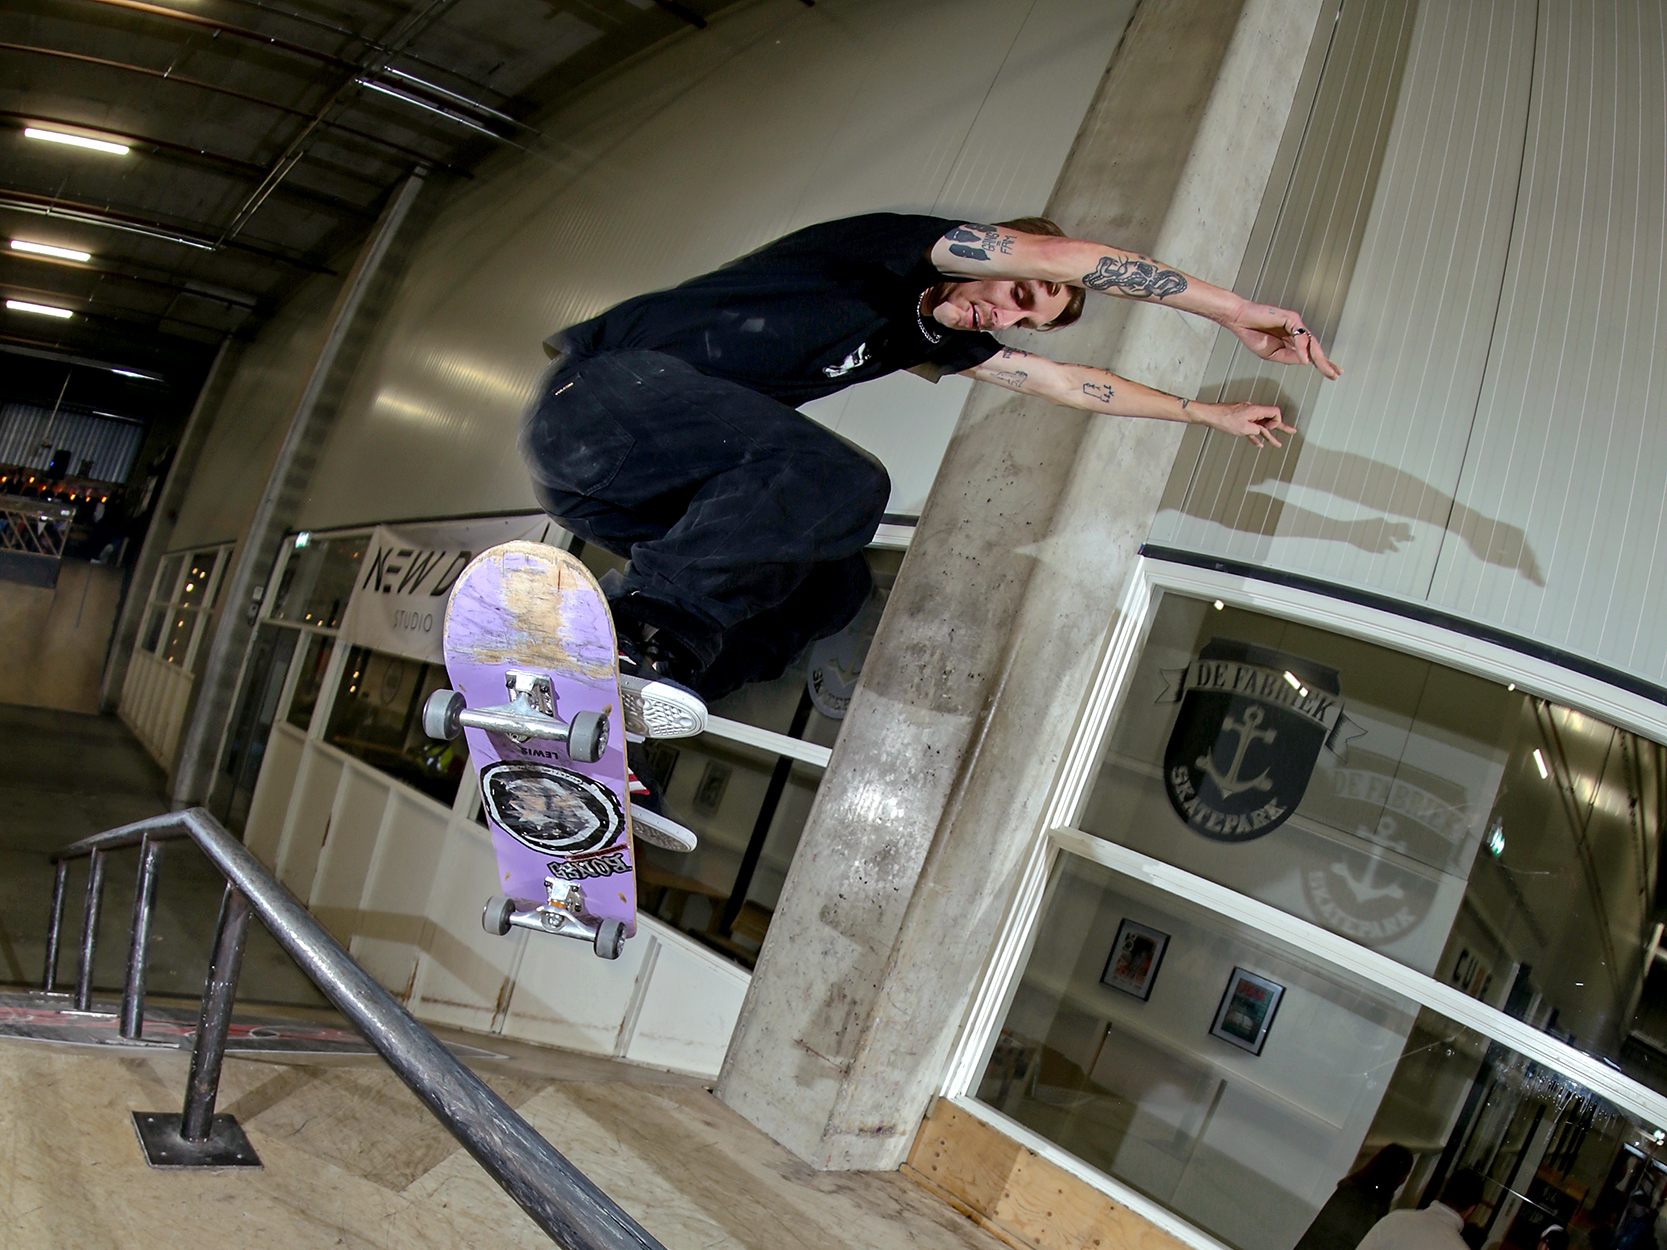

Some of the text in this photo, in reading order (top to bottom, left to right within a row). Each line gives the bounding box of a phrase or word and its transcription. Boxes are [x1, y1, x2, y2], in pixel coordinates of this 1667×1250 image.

[362, 546, 446, 596] NEW
[393, 609, 433, 633] STUDIO
[812, 668, 851, 711] SKATEP
[1196, 662, 1335, 723] DE FABRIEK
[521, 747, 558, 760] LEWIS
[1171, 765, 1287, 834] SKATEPARK
[1308, 871, 1418, 938] SKATEPARK
